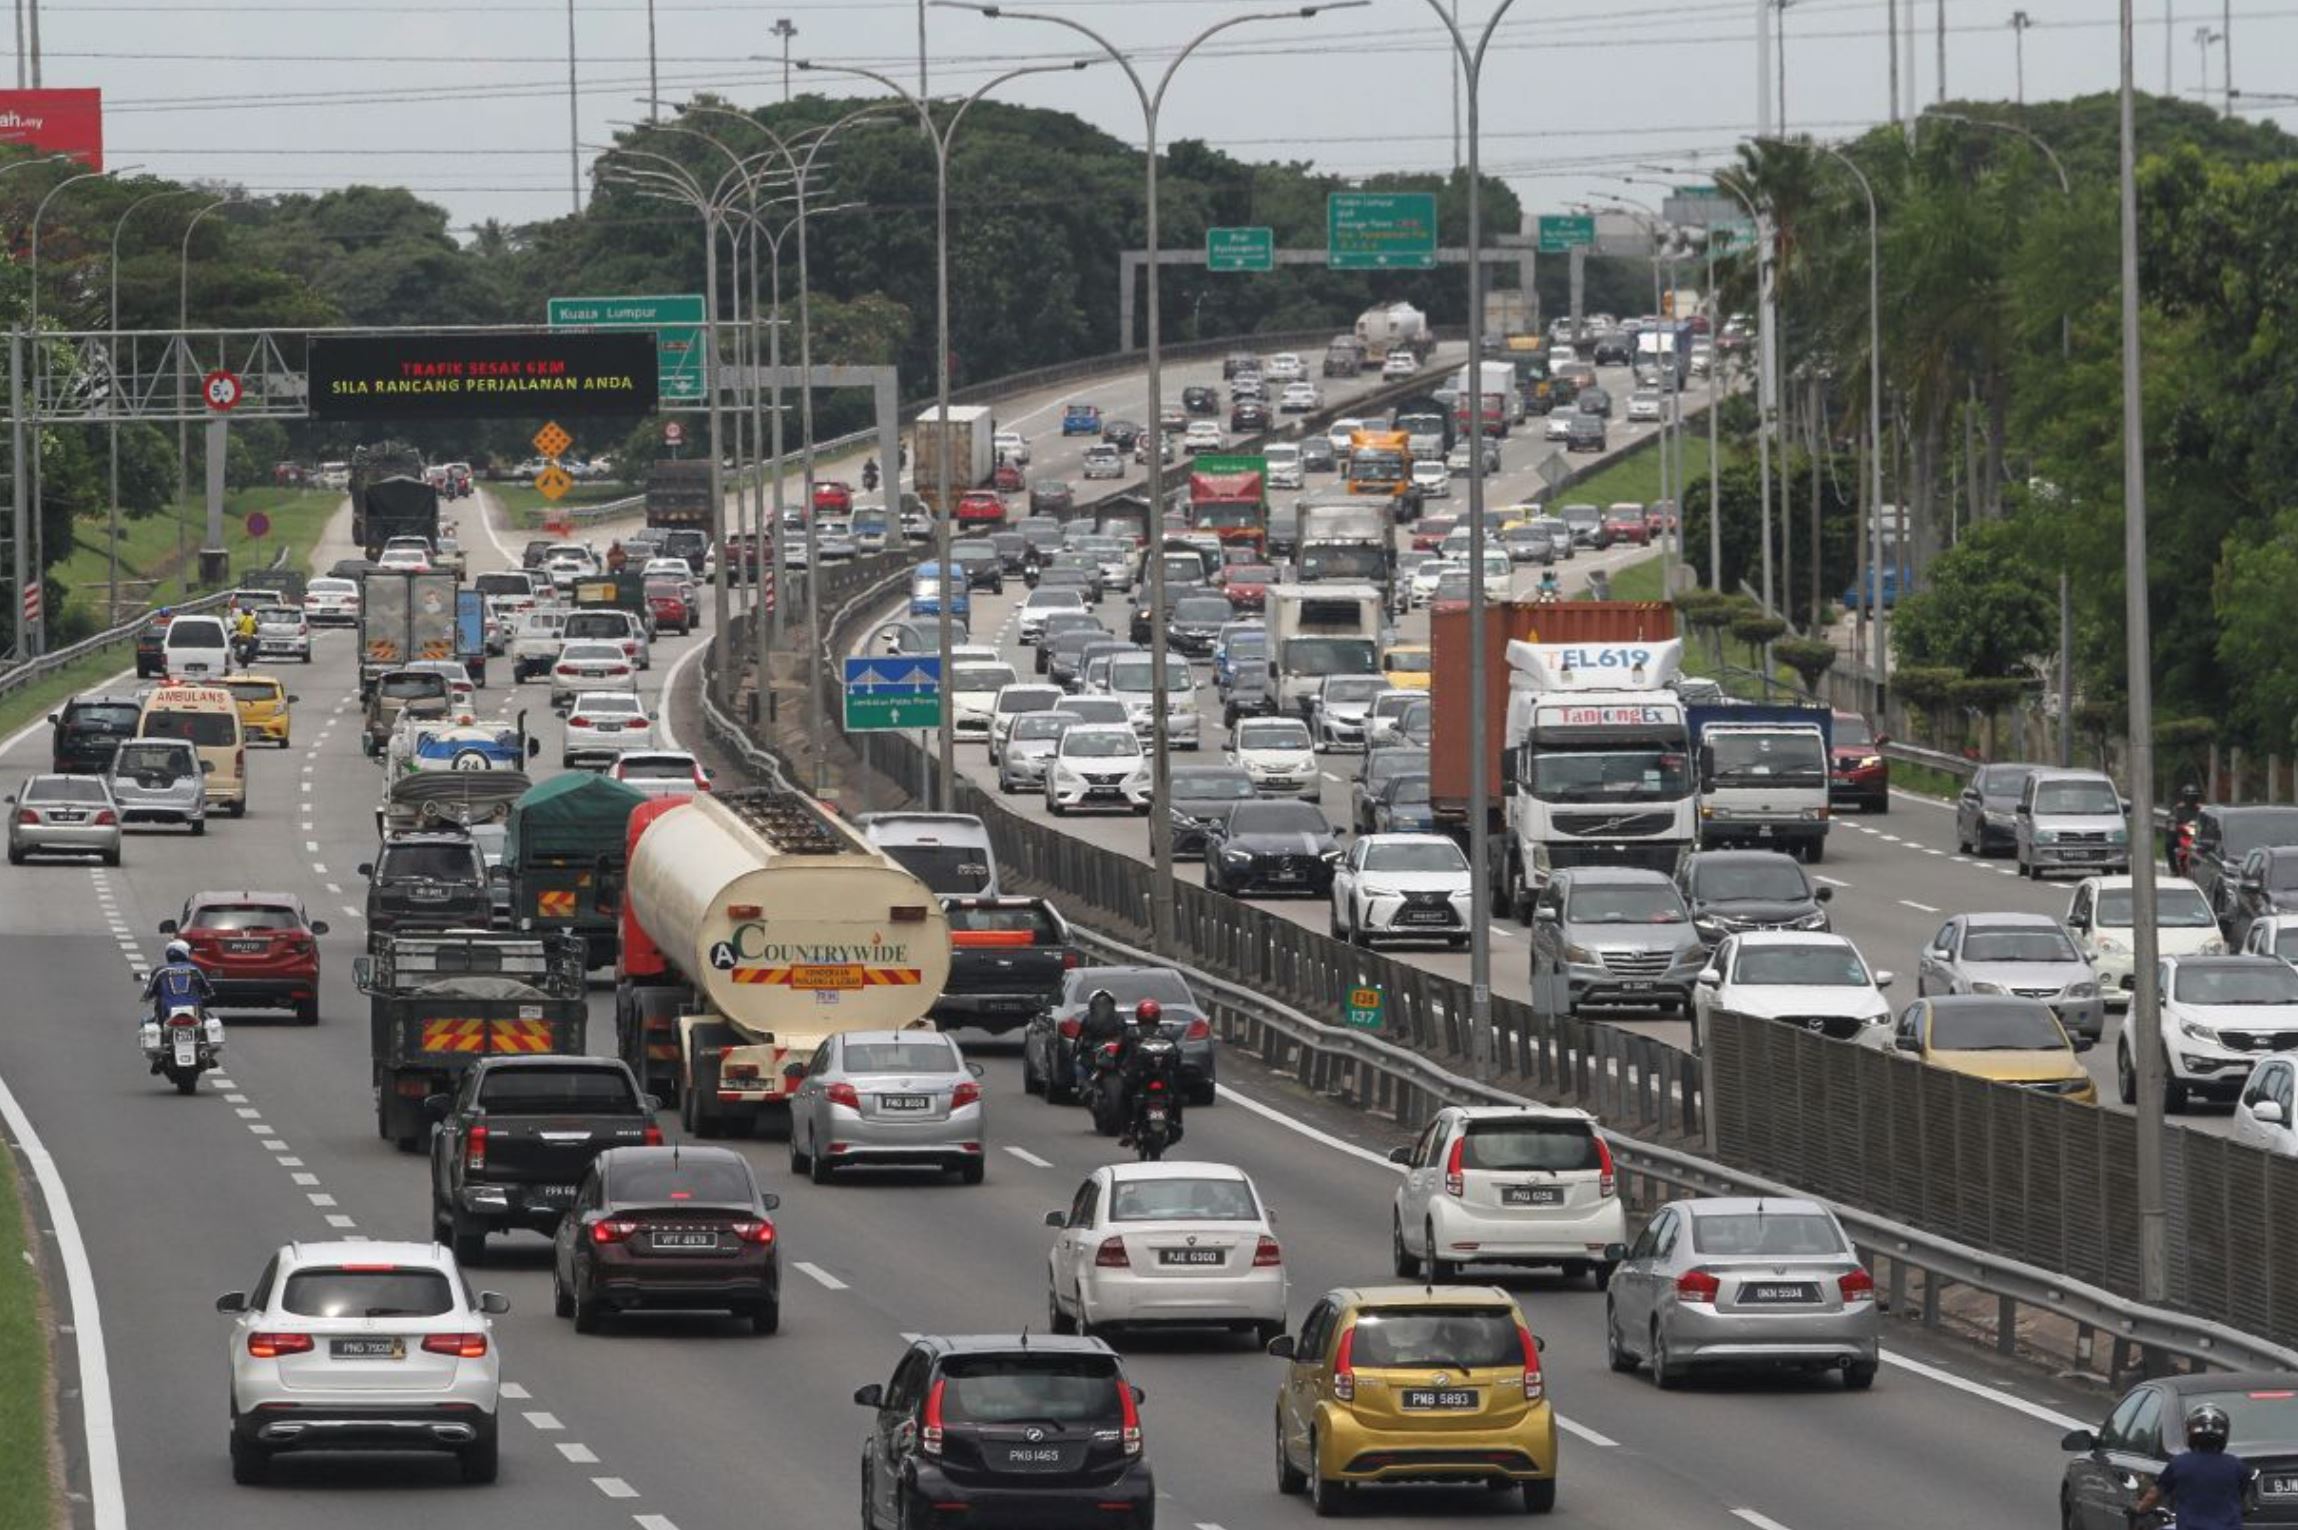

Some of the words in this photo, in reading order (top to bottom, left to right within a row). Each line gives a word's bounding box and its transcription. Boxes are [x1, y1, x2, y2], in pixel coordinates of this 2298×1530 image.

[606, 306, 657, 320] Lumpur
[401, 361, 462, 376] TRAFIK
[468, 361, 521, 375] SESAK
[331, 381, 369, 394] SILA
[375, 379, 460, 393] RANCANG
[466, 377, 578, 392] PERJALANAN
[583, 376, 634, 390] ANDA
[1542, 649, 1650, 670] TEL619
[157, 690, 226, 704] AMBULANS
[714, 943, 735, 966] A
[1352, 1010, 1376, 1024] 137
[1412, 1393, 1435, 1405] PMB
[1439, 1392, 1469, 1405] 5893
